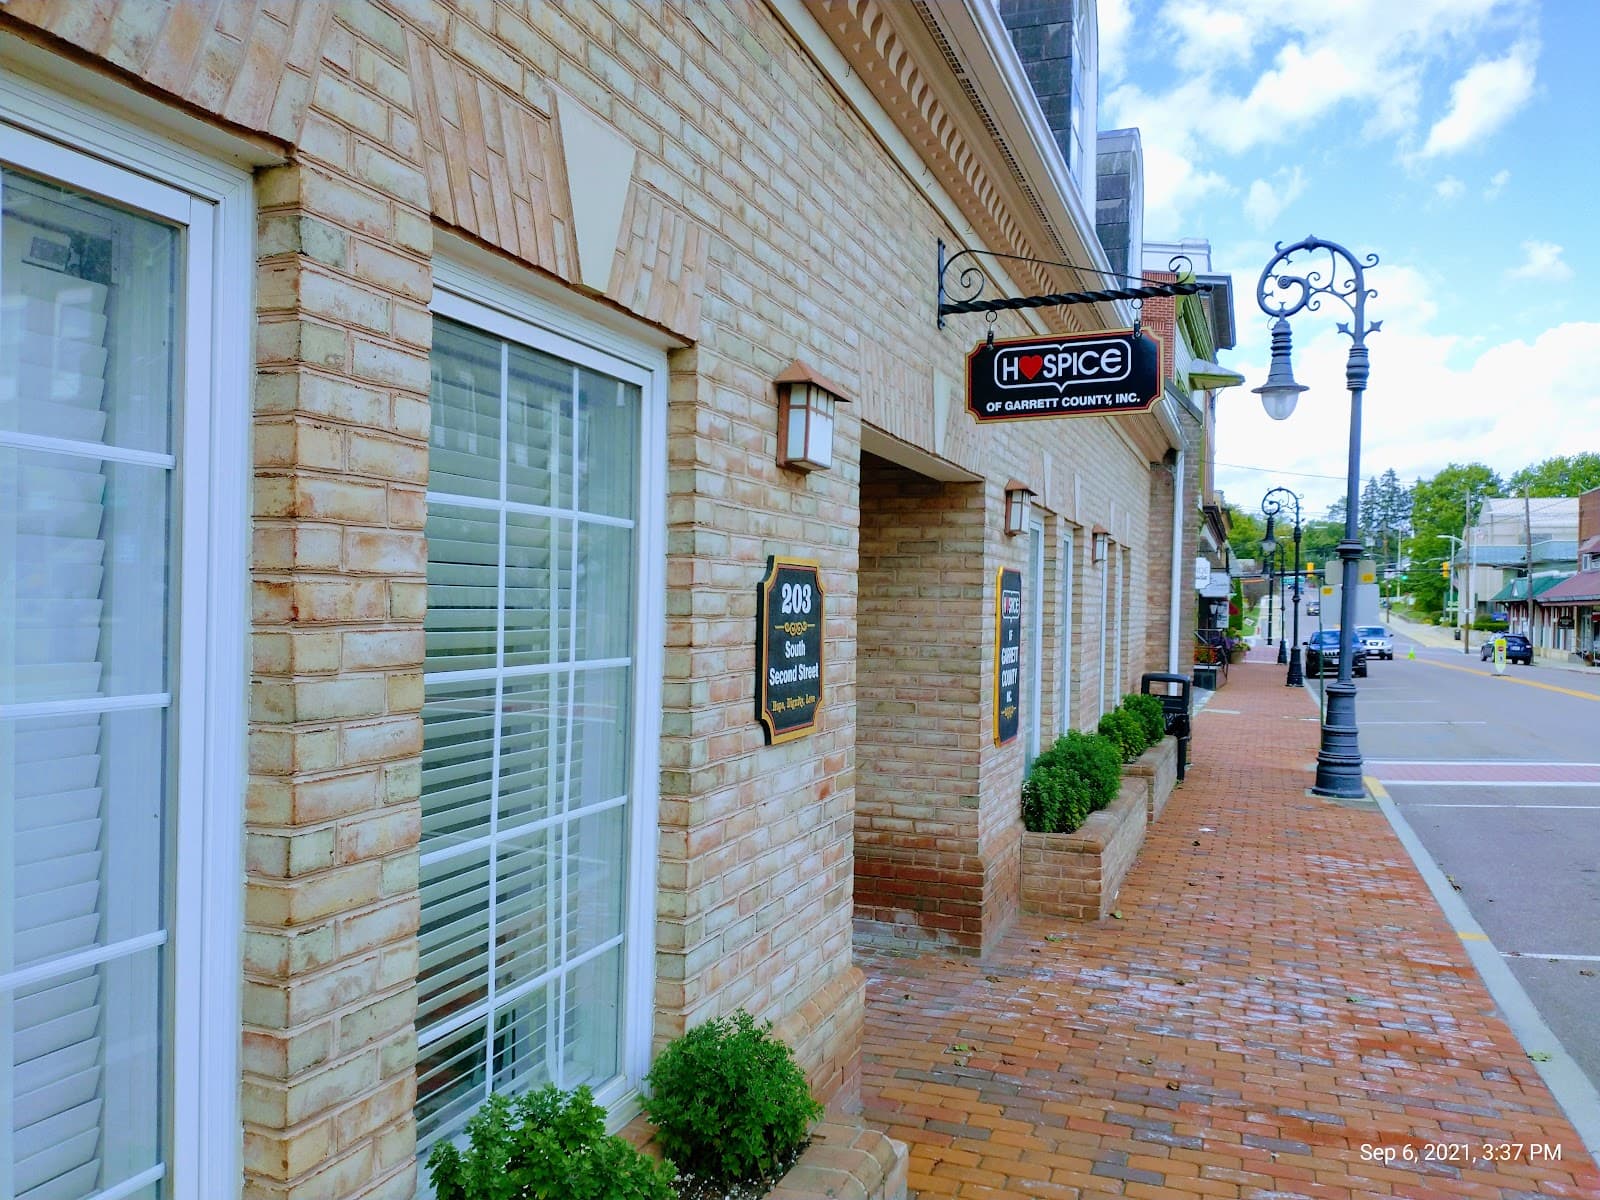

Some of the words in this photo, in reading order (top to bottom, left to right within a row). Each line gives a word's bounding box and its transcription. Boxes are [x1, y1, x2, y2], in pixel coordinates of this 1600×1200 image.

[986, 401, 1002, 412] OF
[1004, 398, 1059, 411] GARRETT
[1063, 394, 1113, 407] COUNTY,
[1115, 392, 1141, 403] INC.
[781, 583, 812, 614] 203
[784, 640, 806, 659] South
[769, 665, 798, 686] Second
[798, 662, 819, 682] Street
